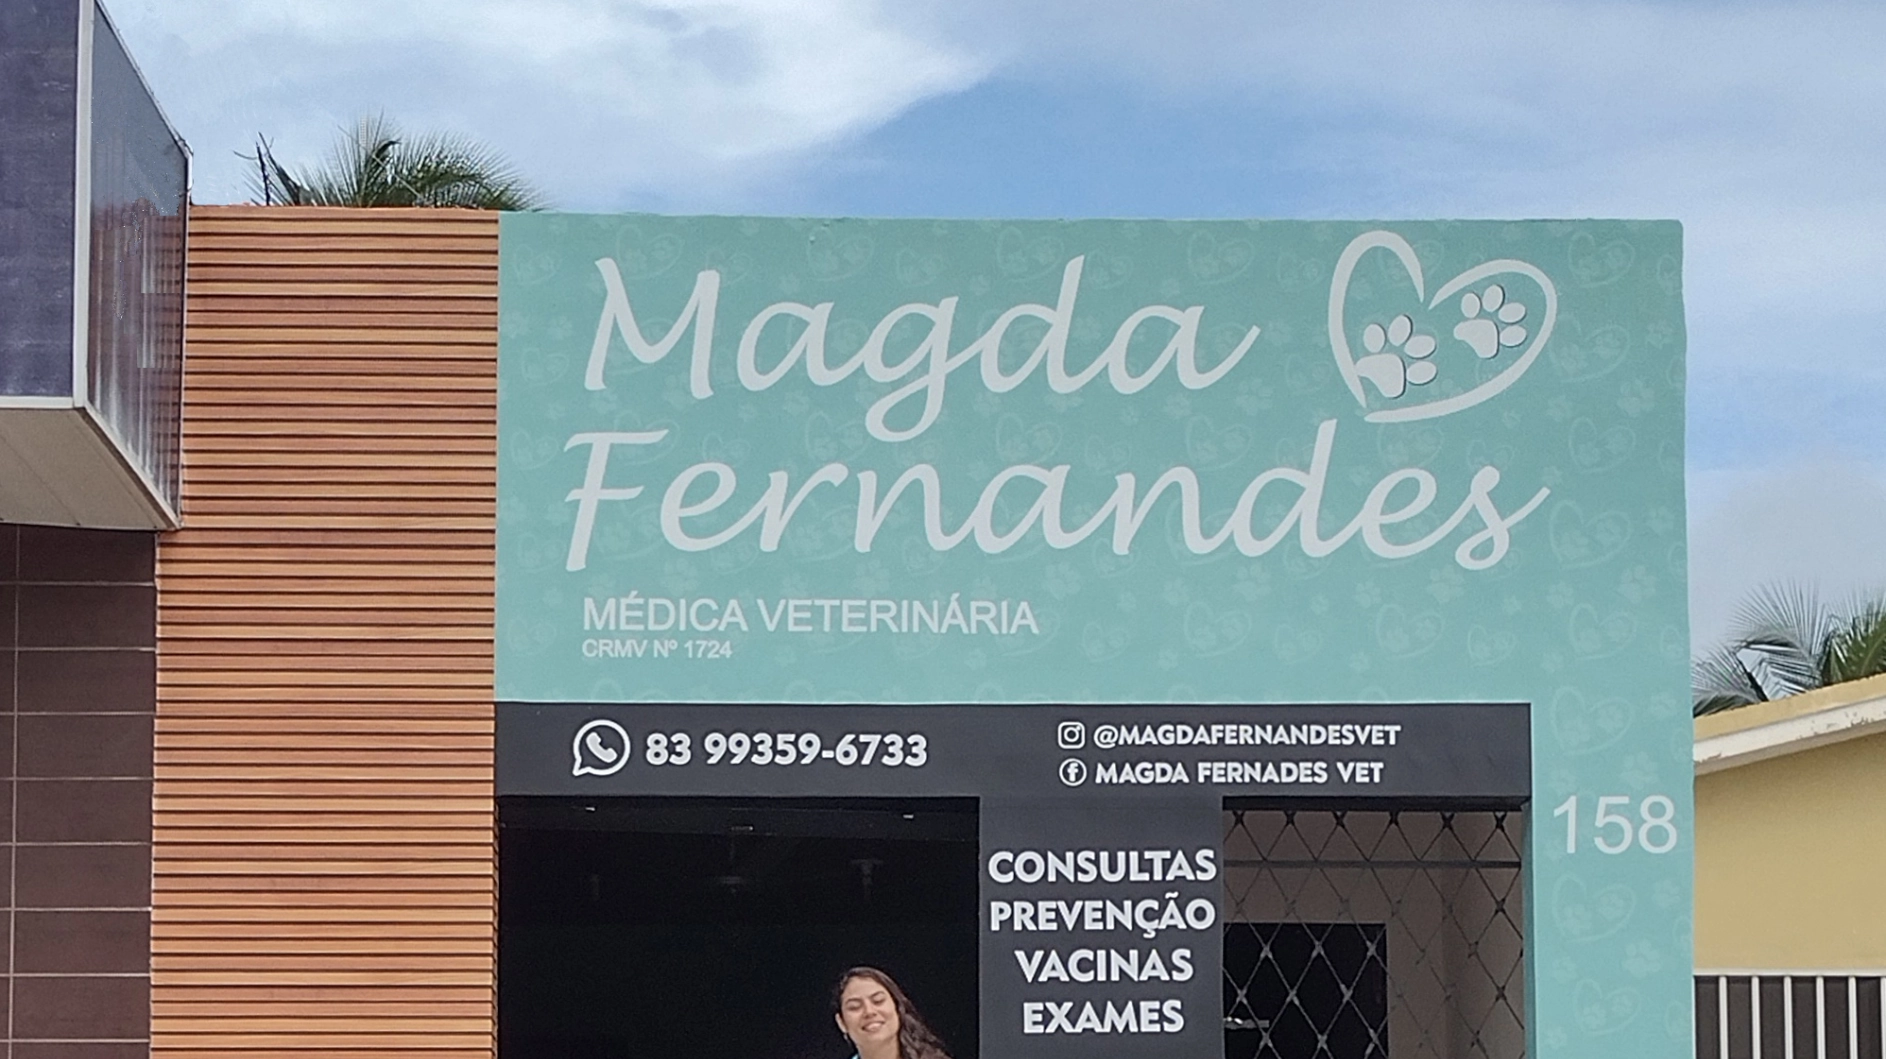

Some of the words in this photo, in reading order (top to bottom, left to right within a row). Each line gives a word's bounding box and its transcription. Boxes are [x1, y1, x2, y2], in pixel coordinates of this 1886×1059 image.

[584, 254, 1261, 442] Magda
[563, 418, 1551, 572] Fernandes
[583, 590, 748, 632] MÉDICA
[756, 592, 1040, 634] VETERINÁRIA
[582, 639, 647, 658] CRMV
[654, 640, 677, 658] Nº
[684, 640, 732, 659] 1724
[646, 732, 692, 766] 83
[704, 732, 928, 767] 99359-6733
[1093, 724, 1402, 749] @MAGDAFERNANDESVET
[1095, 761, 1189, 784] MAGDA
[1198, 762, 1328, 784] FERNADES
[1336, 762, 1385, 784] VET
[1553, 794, 1678, 855] 158
[988, 849, 1217, 884] CONSULTAS
[989, 891, 1216, 939] PREVENÇÃO
[1014, 948, 1194, 983] VACINAS
[1023, 999, 1185, 1034] EXAMES
